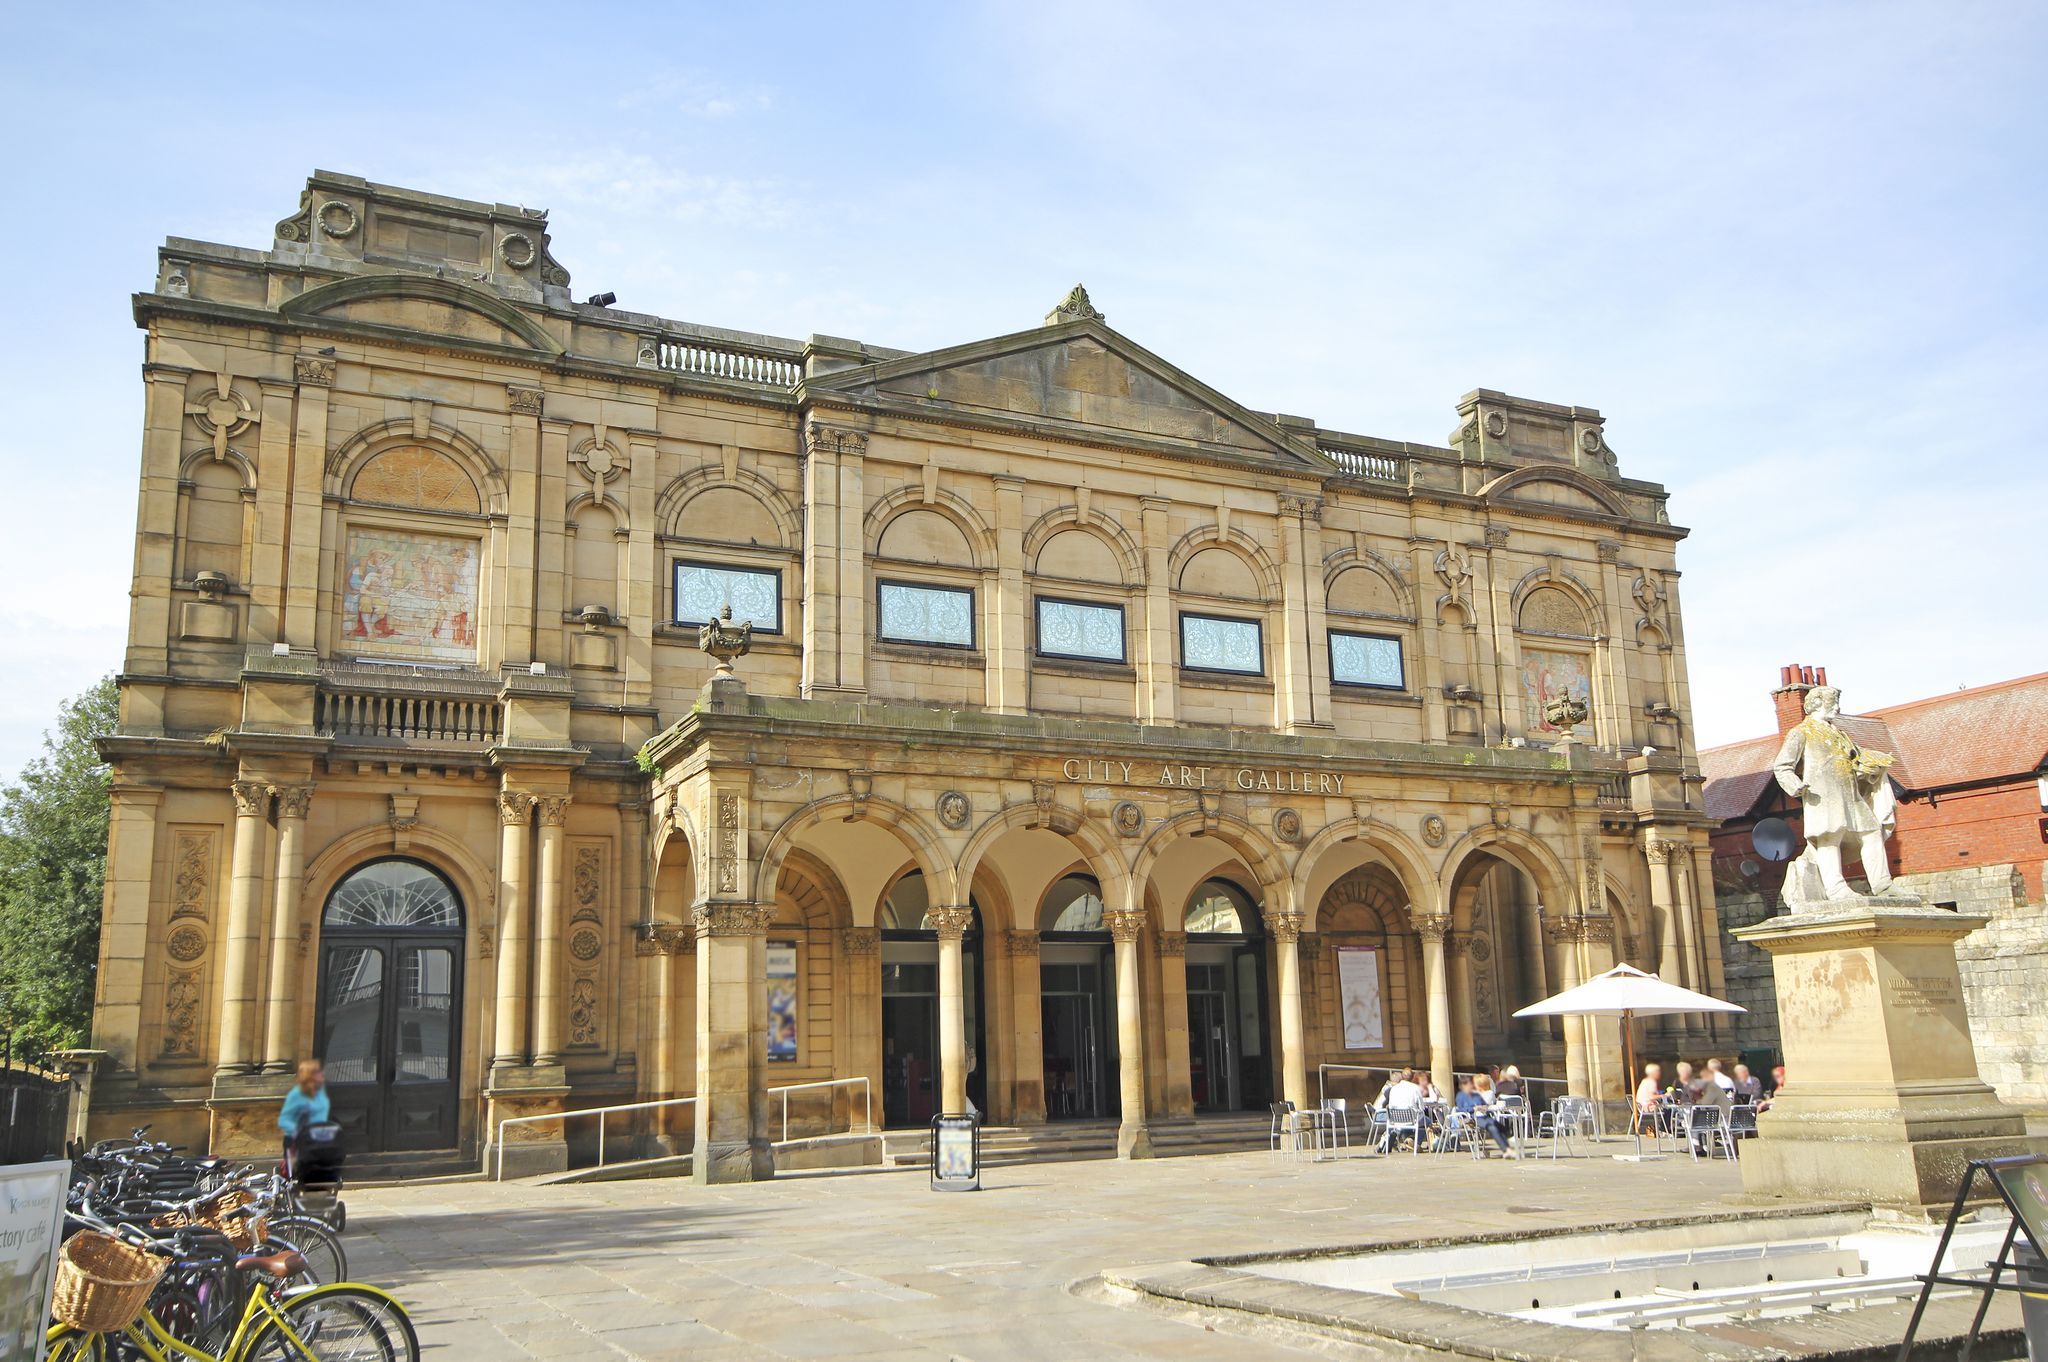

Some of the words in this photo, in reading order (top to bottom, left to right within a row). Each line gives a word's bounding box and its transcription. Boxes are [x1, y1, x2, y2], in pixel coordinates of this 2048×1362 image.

[1062, 758, 1133, 783] CITY
[1159, 764, 1211, 788] ART
[1236, 769, 1345, 794] GALLERY
[26, 1219, 47, 1243] café
